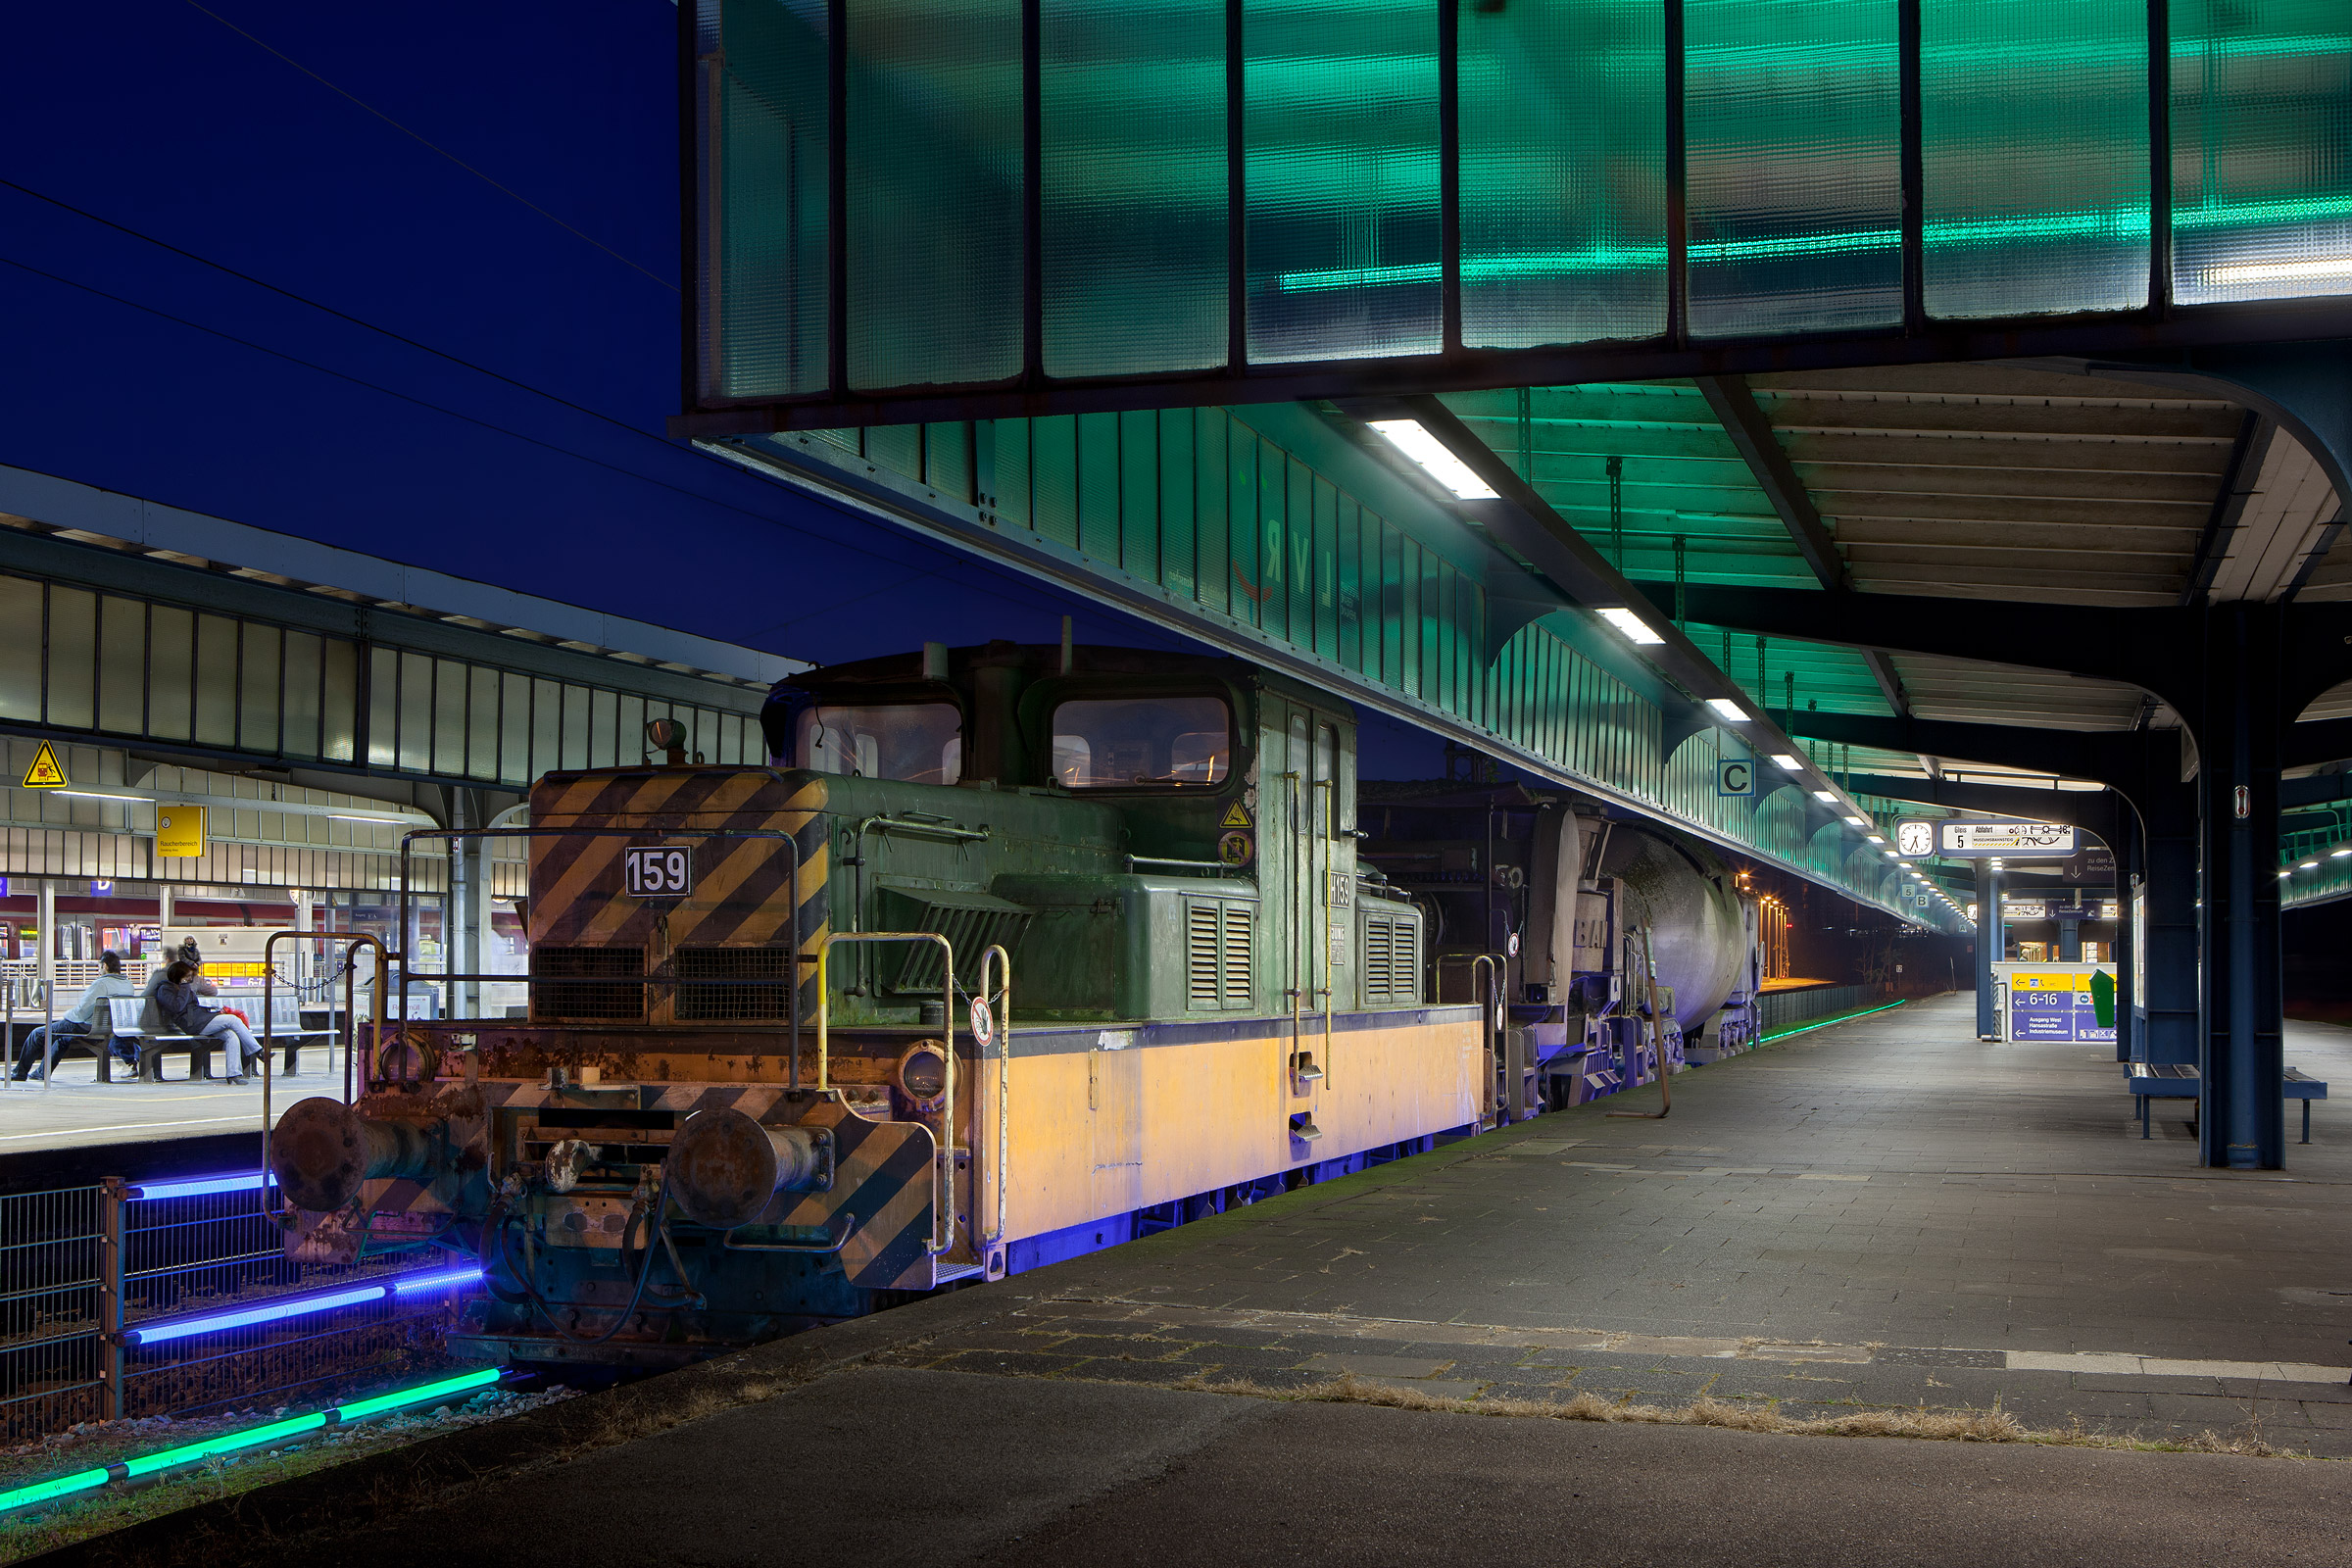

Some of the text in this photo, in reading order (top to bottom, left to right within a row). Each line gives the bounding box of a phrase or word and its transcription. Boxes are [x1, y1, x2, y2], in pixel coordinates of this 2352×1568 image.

[1725, 764, 1747, 791] C
[1957, 835, 1964, 848] 5
[627, 852, 685, 891] 159
[1918, 897, 1926, 906] B
[2030, 993, 2058, 1005] 6-16
